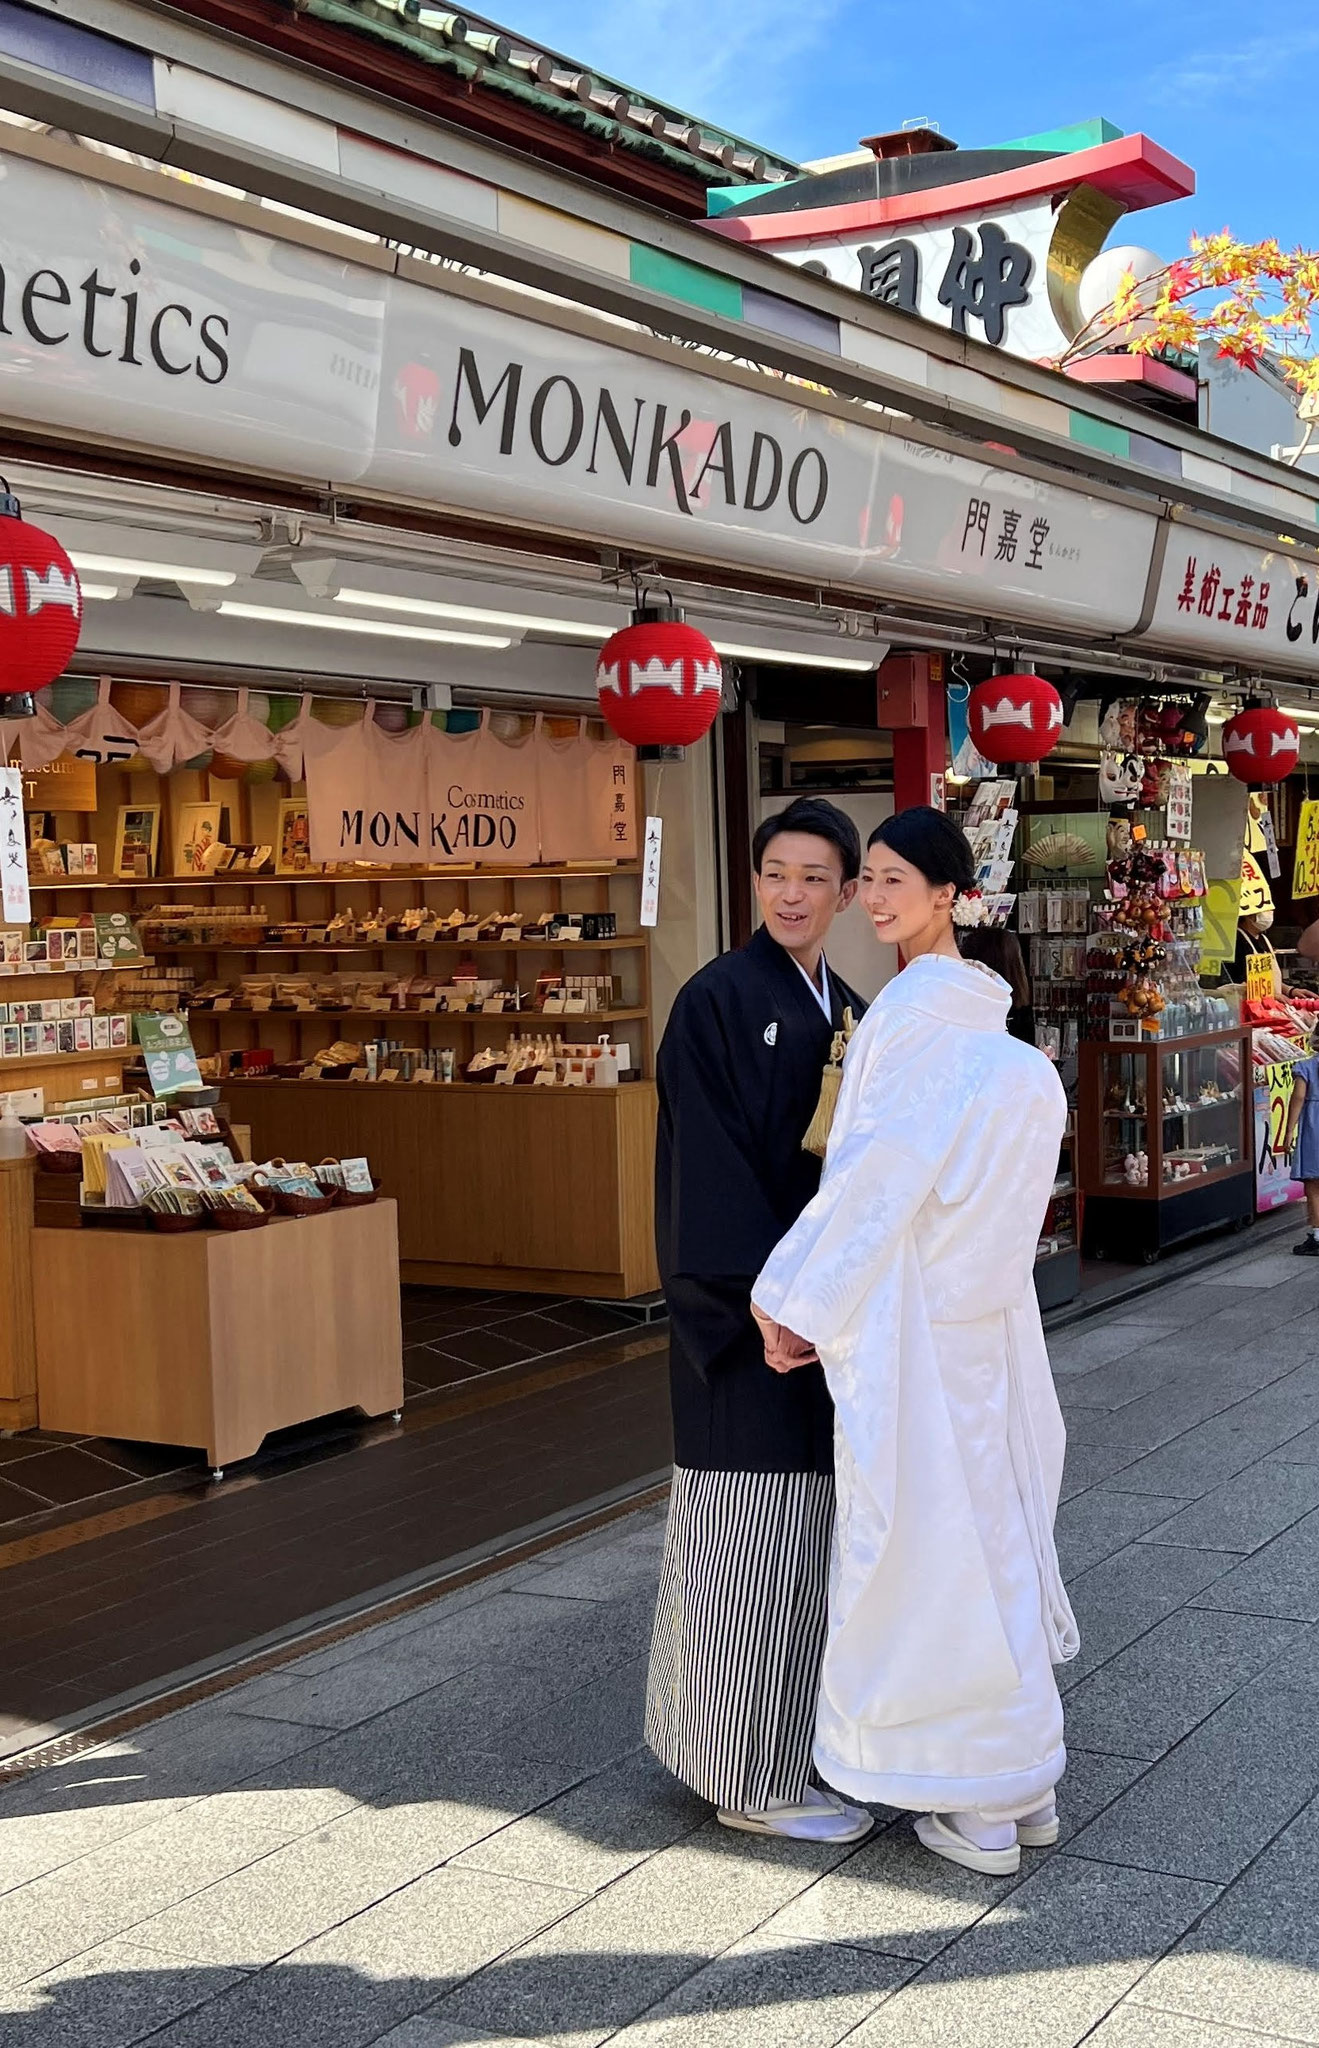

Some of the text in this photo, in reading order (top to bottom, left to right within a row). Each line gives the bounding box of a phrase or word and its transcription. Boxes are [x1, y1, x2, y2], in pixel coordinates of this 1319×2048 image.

[448, 346, 828, 524] MONKADO
[961, 498, 1050, 570] 門嘉堂
[1177, 556, 1319, 644] 美術工芸品 こ
[612, 765, 628, 841] 門嘉堂
